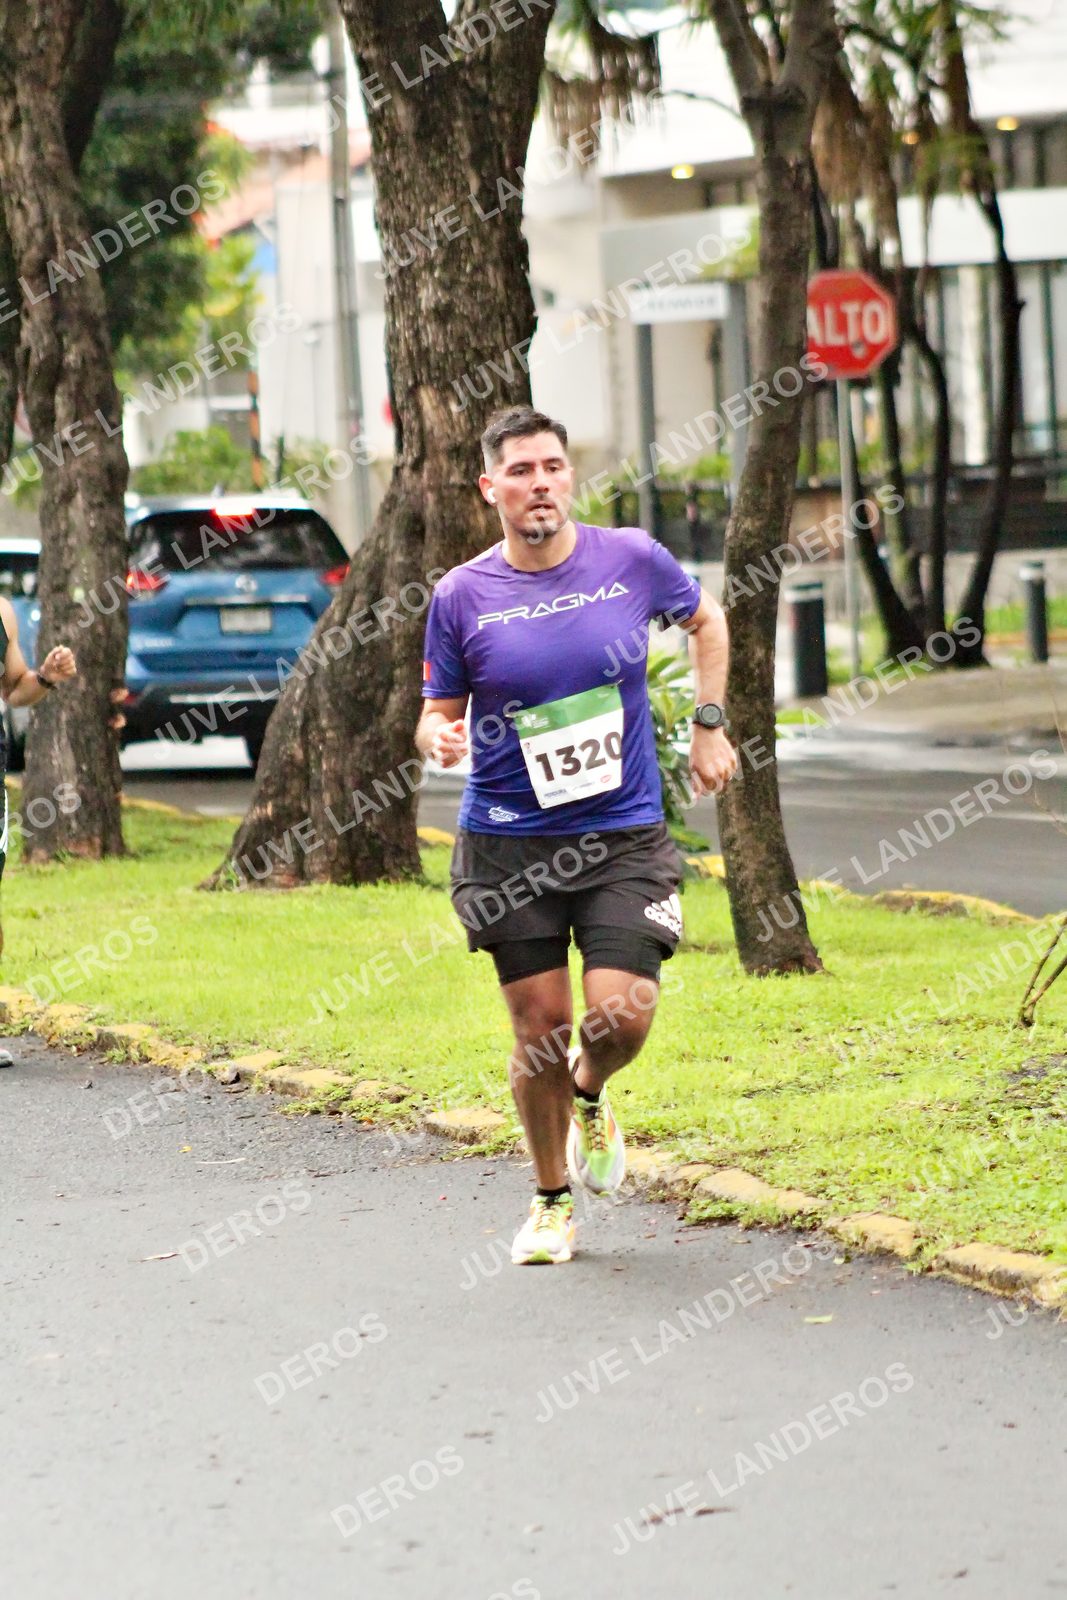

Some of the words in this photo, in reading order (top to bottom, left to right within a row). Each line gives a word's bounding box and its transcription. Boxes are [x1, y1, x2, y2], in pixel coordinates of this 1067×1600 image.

[807, 300, 886, 347] ALTO
[477, 582, 629, 630] PRAGMA
[534, 731, 623, 782] 1320
